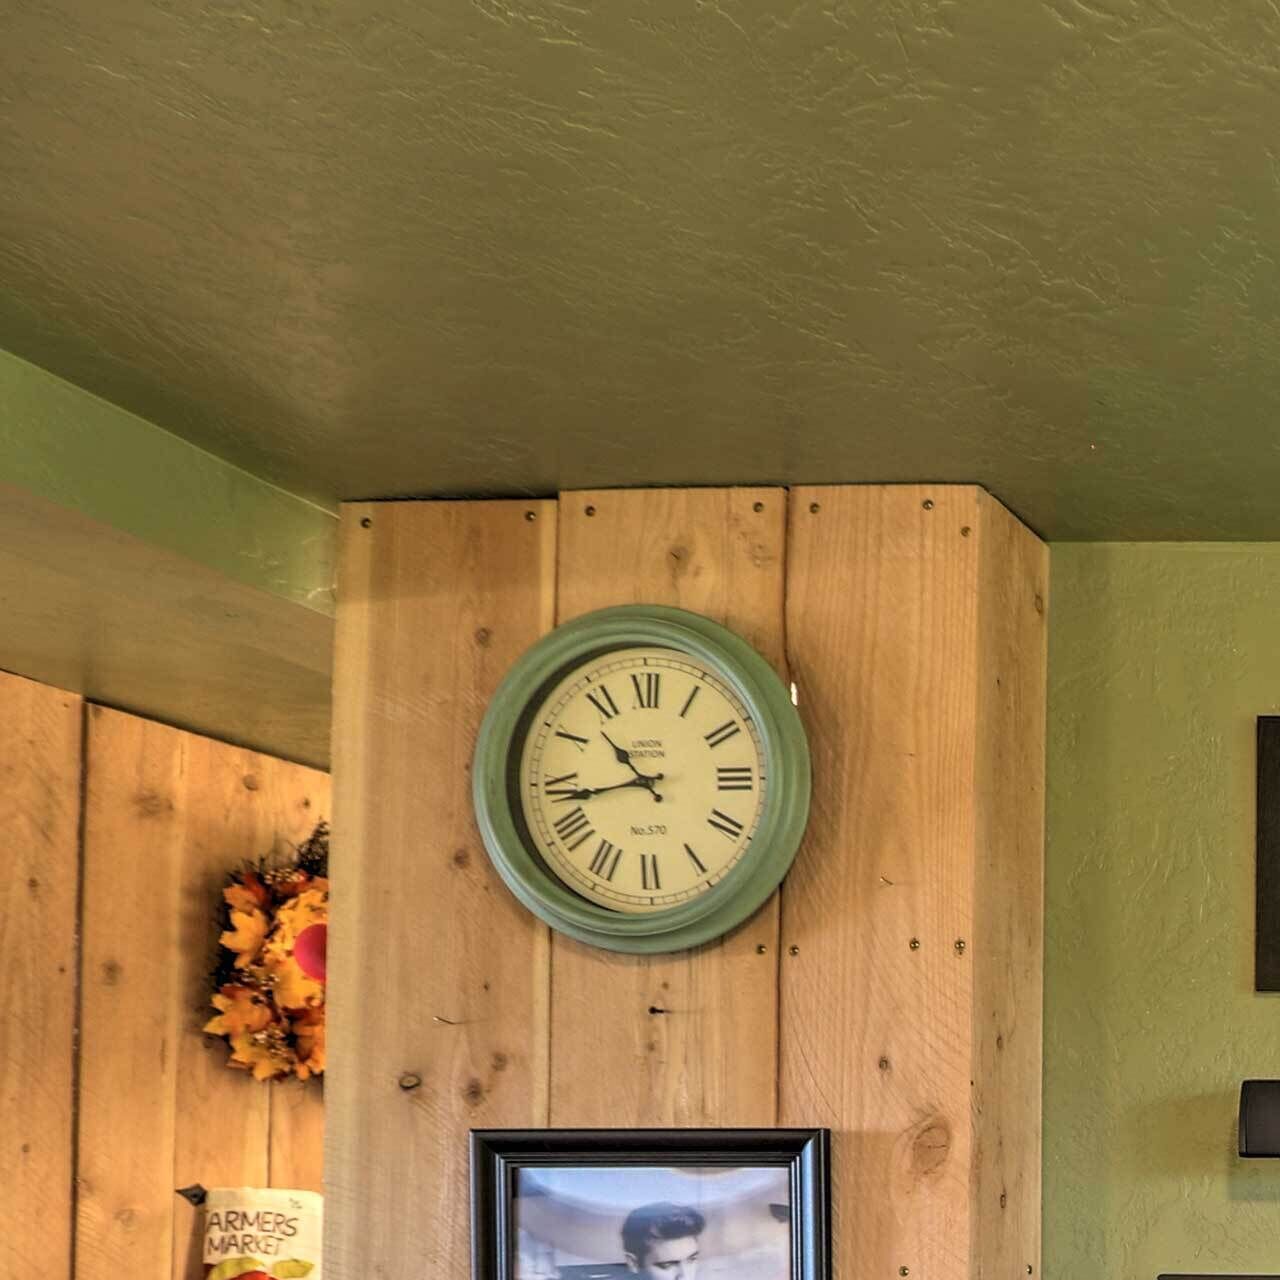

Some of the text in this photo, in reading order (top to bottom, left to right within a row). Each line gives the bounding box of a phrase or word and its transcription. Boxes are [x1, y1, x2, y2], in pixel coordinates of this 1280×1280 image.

[631, 740, 662, 749] UNION
[628, 750, 665, 759] STATION
[204, 1210, 300, 1237] ARMERS
[208, 1233, 284, 1256] MARKET
